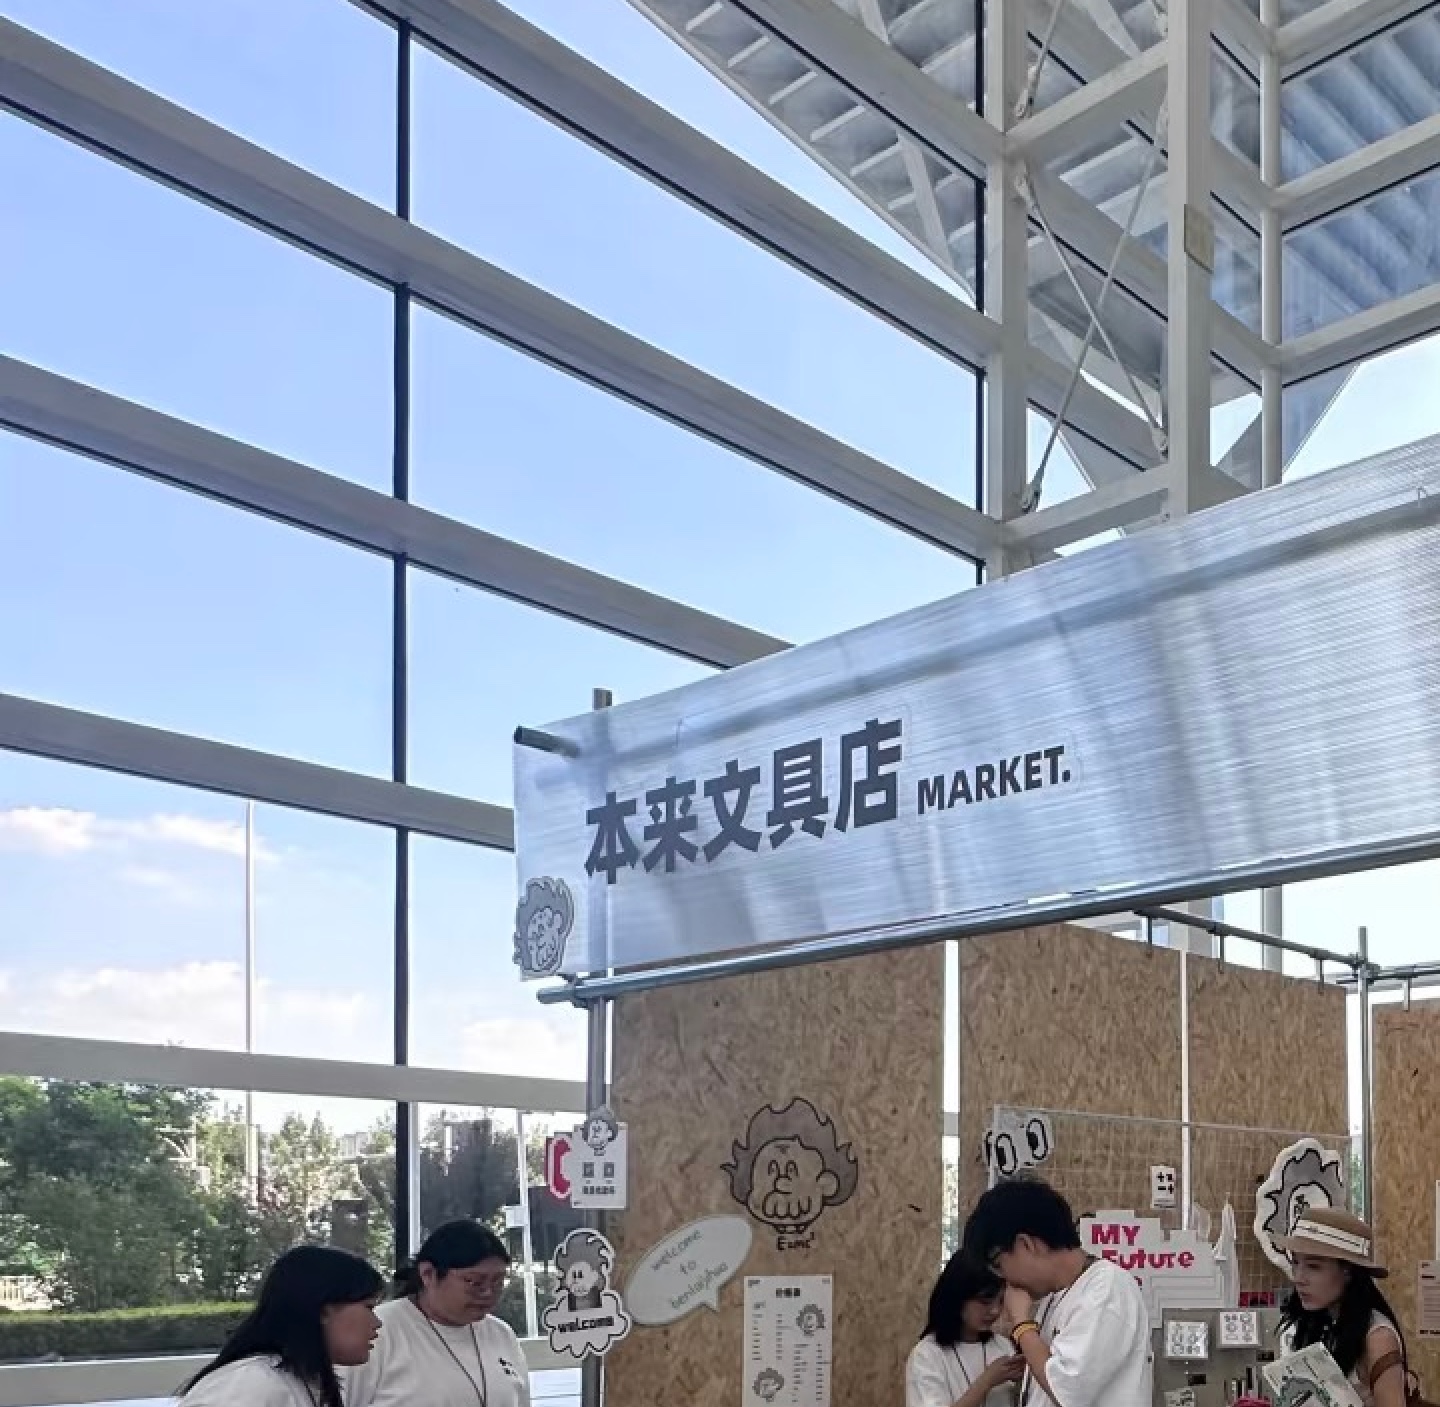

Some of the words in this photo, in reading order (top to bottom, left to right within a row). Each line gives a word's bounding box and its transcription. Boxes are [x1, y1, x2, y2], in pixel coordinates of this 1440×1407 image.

[584, 718, 902, 884] 本来文具店
[917, 745, 1071, 814] MARKET.
[1091, 1224, 1140, 1246] MY
[1101, 1248, 1194, 1270] Future
